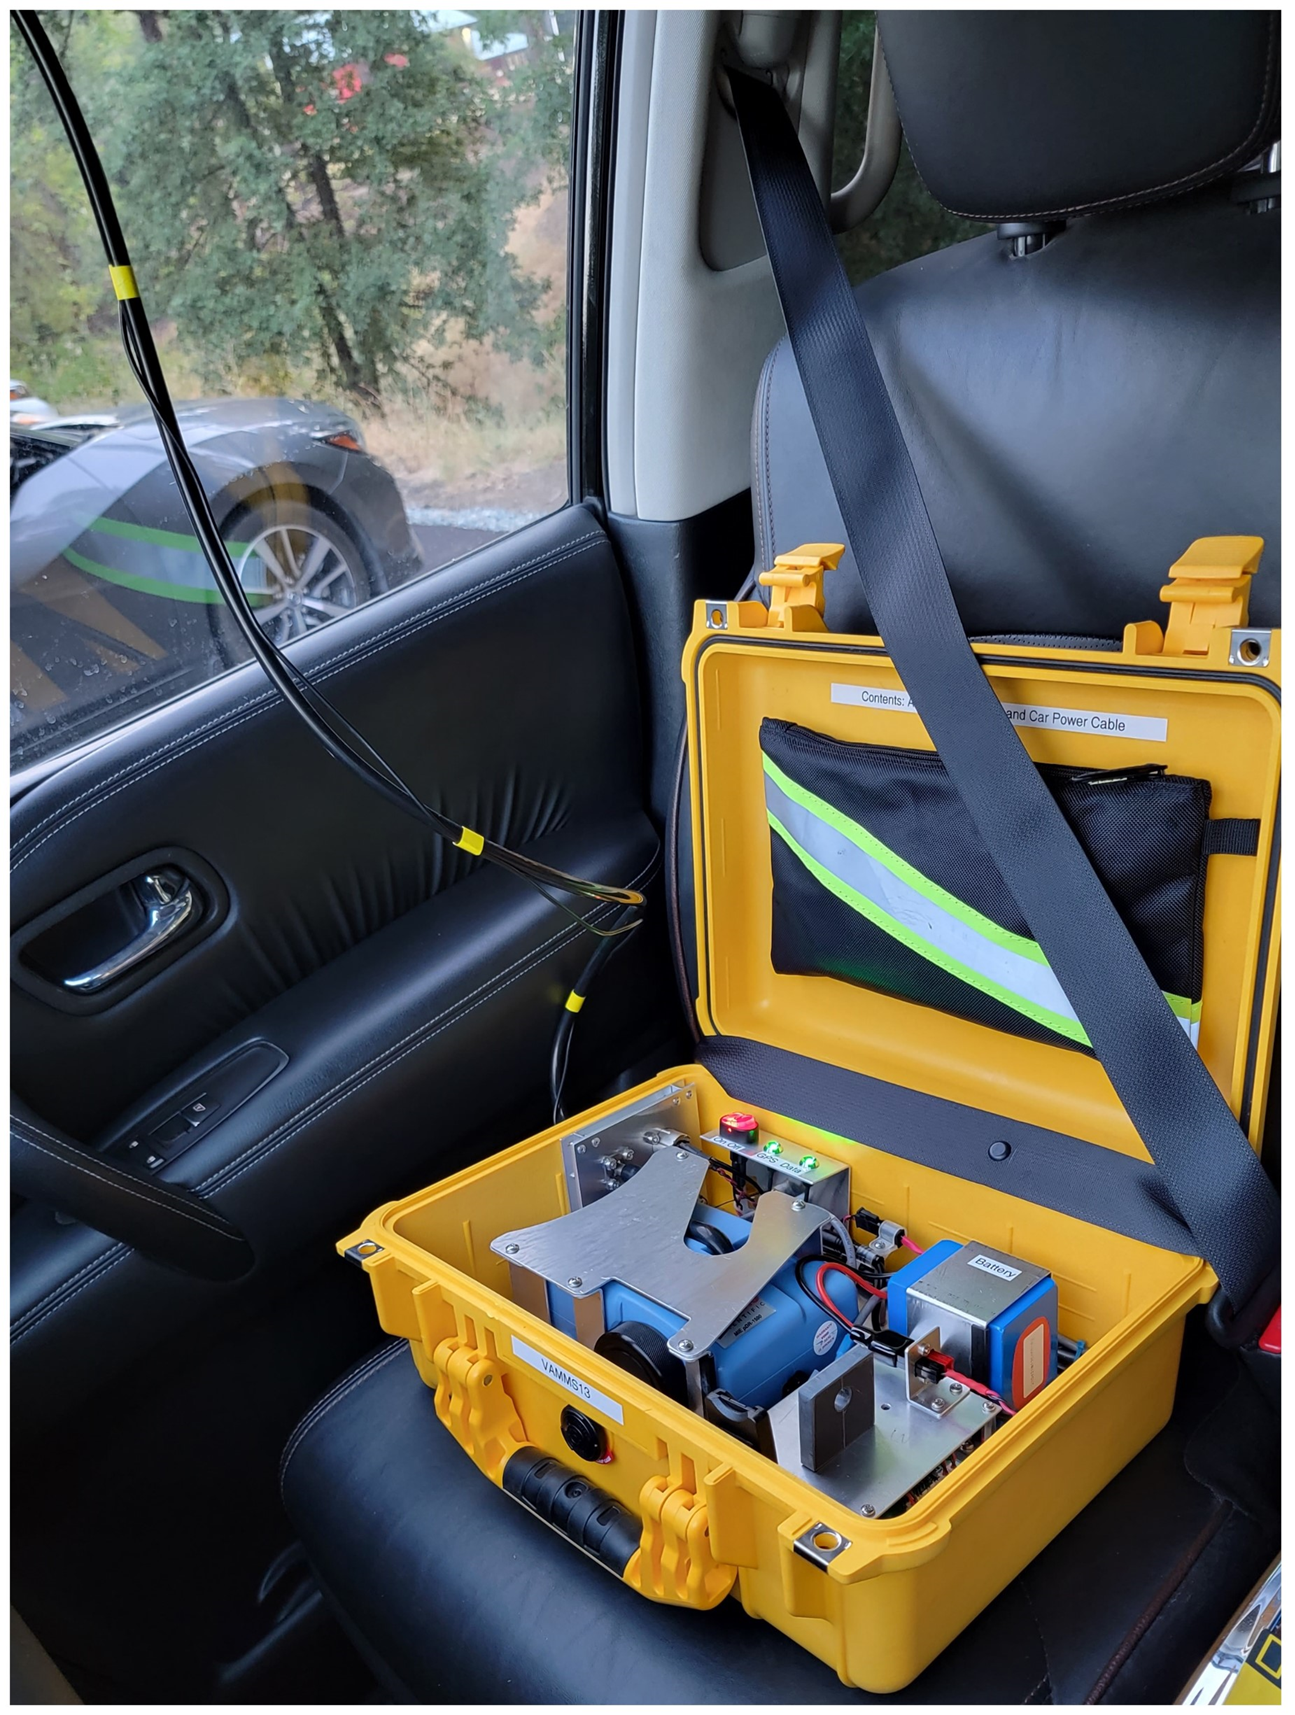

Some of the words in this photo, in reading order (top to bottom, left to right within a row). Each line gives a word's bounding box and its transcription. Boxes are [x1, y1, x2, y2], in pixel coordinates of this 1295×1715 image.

[861, 690, 905, 707] Contents:
[1006, 709, 1026, 721] and
[1029, 709, 1050, 723] Car
[1052, 712, 1088, 728] Power
[1090, 716, 1126, 732] Cable
[713, 1136, 726, 1144] On
[726, 1141, 744, 1151] Off
[756, 1152, 779, 1164] GPS
[780, 1162, 802, 1174] Data
[974, 1257, 1017, 1278] Battery
[541, 1358, 592, 1399] VAMMS13
